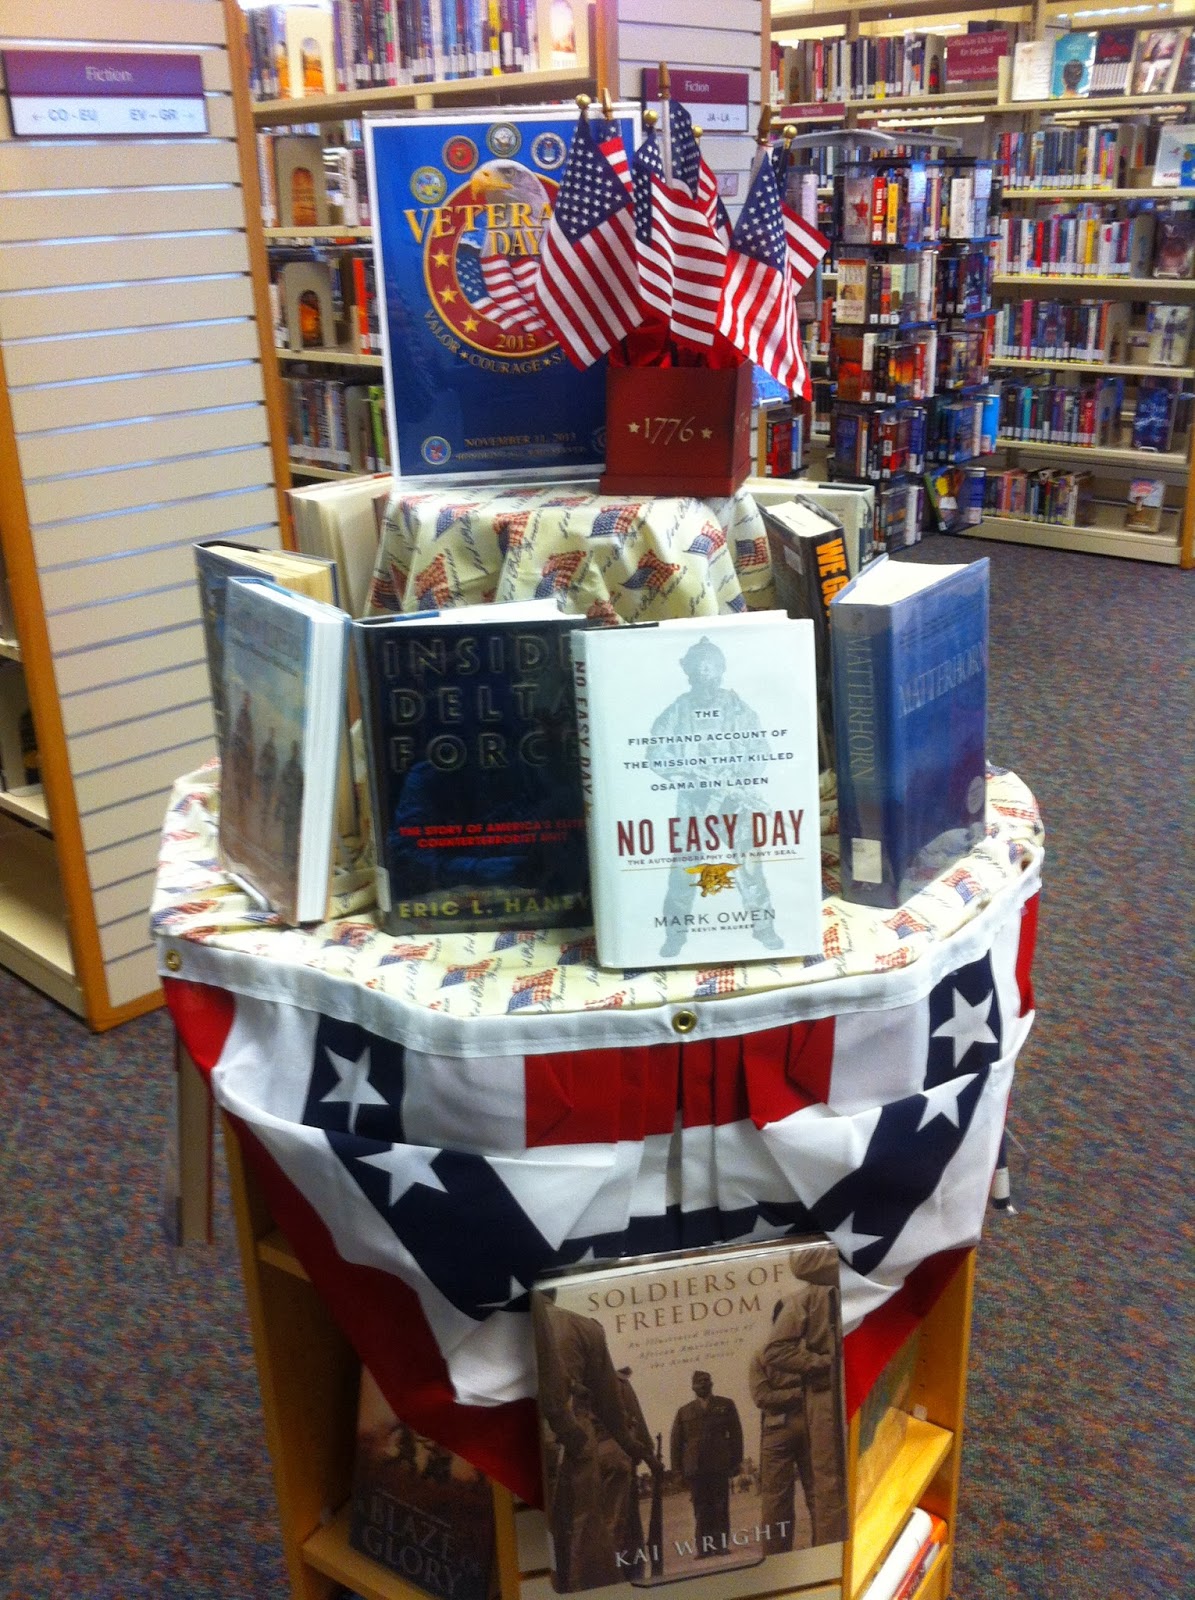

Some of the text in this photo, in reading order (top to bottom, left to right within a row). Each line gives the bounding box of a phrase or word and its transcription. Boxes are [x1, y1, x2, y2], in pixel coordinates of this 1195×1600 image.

[85, 66, 133, 82] Fiction
[685, 80, 710, 92] Fiction
[489, 229, 545, 256] DAY
[424, 309, 543, 373] VALOR COURAGE
[495, 333, 538, 350] 2013
[644, 416, 696, 445] 1776
[816, 537, 848, 577] WE
[695, 710, 720, 718] THE
[848, 635, 876, 784] MATTERHORN
[575, 661, 593, 795] NO EASY DAY
[628, 729, 788, 746] FIRSTHAND ACCOUNT OF
[624, 752, 794, 769] THE MISSION THAT KILLED
[650, 777, 769, 792] OSAMA BIN LADEN
[400, 827, 421, 836] THE
[425, 825, 462, 836] STORY
[467, 823, 482, 833] OF
[617, 809, 804, 856] NO EASY DAY
[417, 833, 537, 848] COUNTERTERRORIST
[648, 854, 723, 865] AUTOBIOGRAPHY
[749, 850, 771, 858] NAVY
[399, 901, 460, 918] ERIC
[471, 899, 493, 915] L.
[655, 909, 776, 929] MARK OWEN
[720, 923, 755, 931] MAURER
[588, 1264, 785, 1311] SOLDIERS OF
[615, 1295, 762, 1333] FREEDOM
[615, 1520, 791, 1567] KAI WRIGHT
[362, 1525, 463, 1595] GLORY
